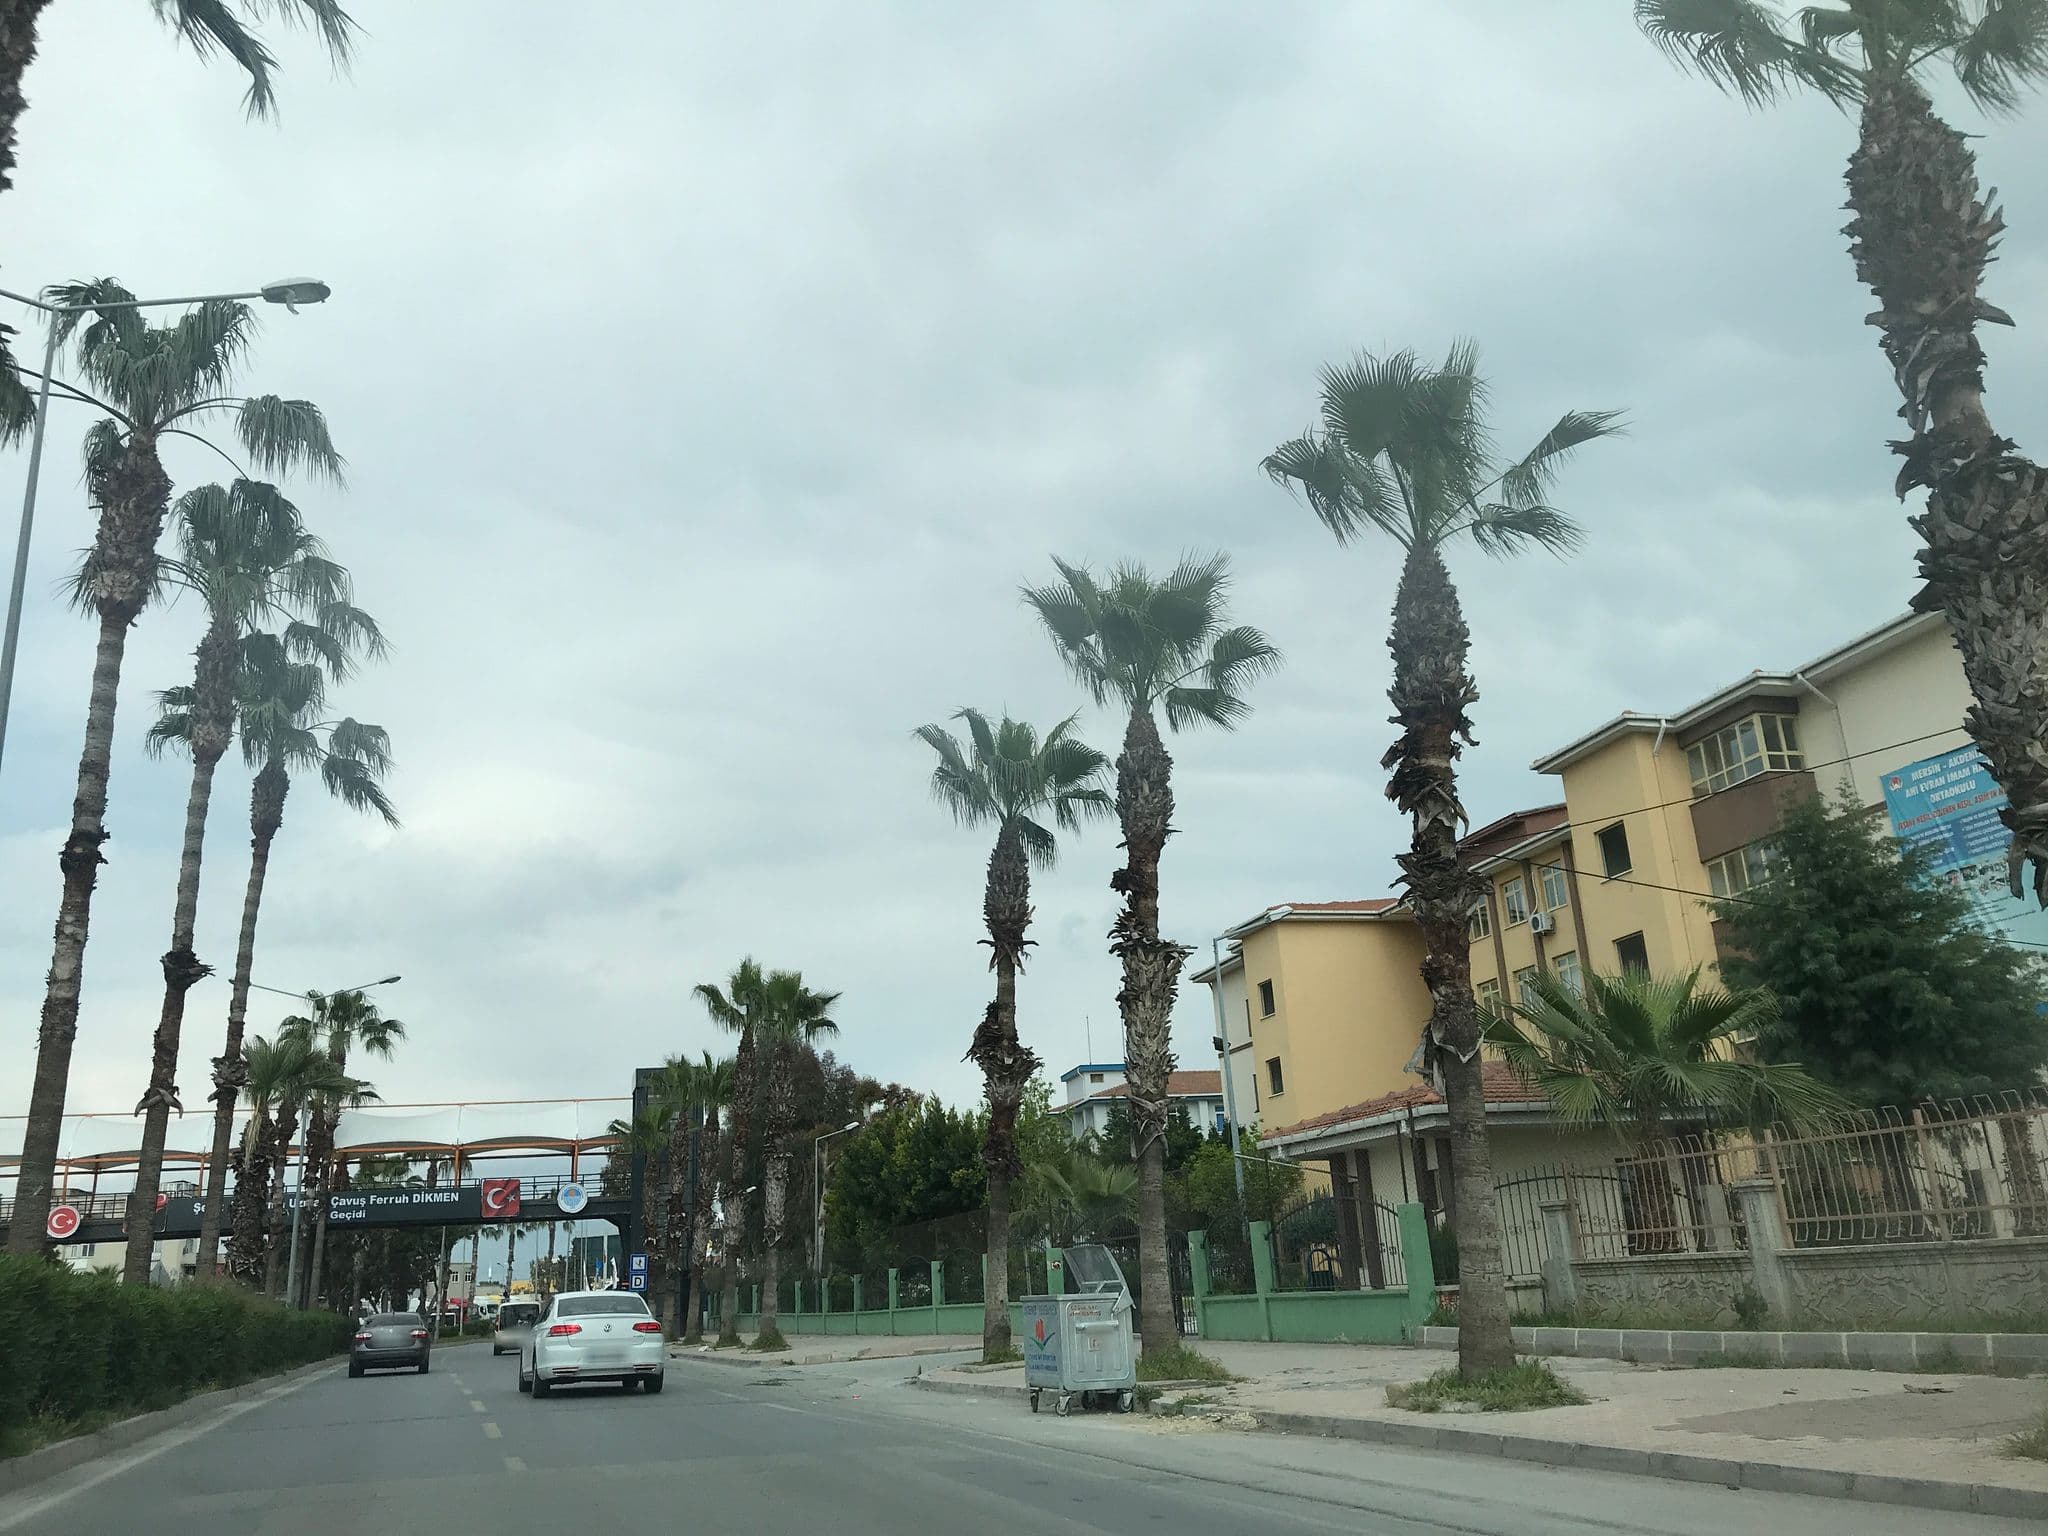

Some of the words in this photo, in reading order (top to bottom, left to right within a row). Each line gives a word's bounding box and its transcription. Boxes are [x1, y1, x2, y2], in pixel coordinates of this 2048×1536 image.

[1930, 780, 1976, 803] ORTAOKULU
[330, 1196, 366, 1208] Çavuş
[370, 1194, 409, 1205] Ferruh
[413, 1191, 459, 1203] DİKMEN
[330, 1210, 366, 1221] Geçidi
[634, 1277, 642, 1286] D
